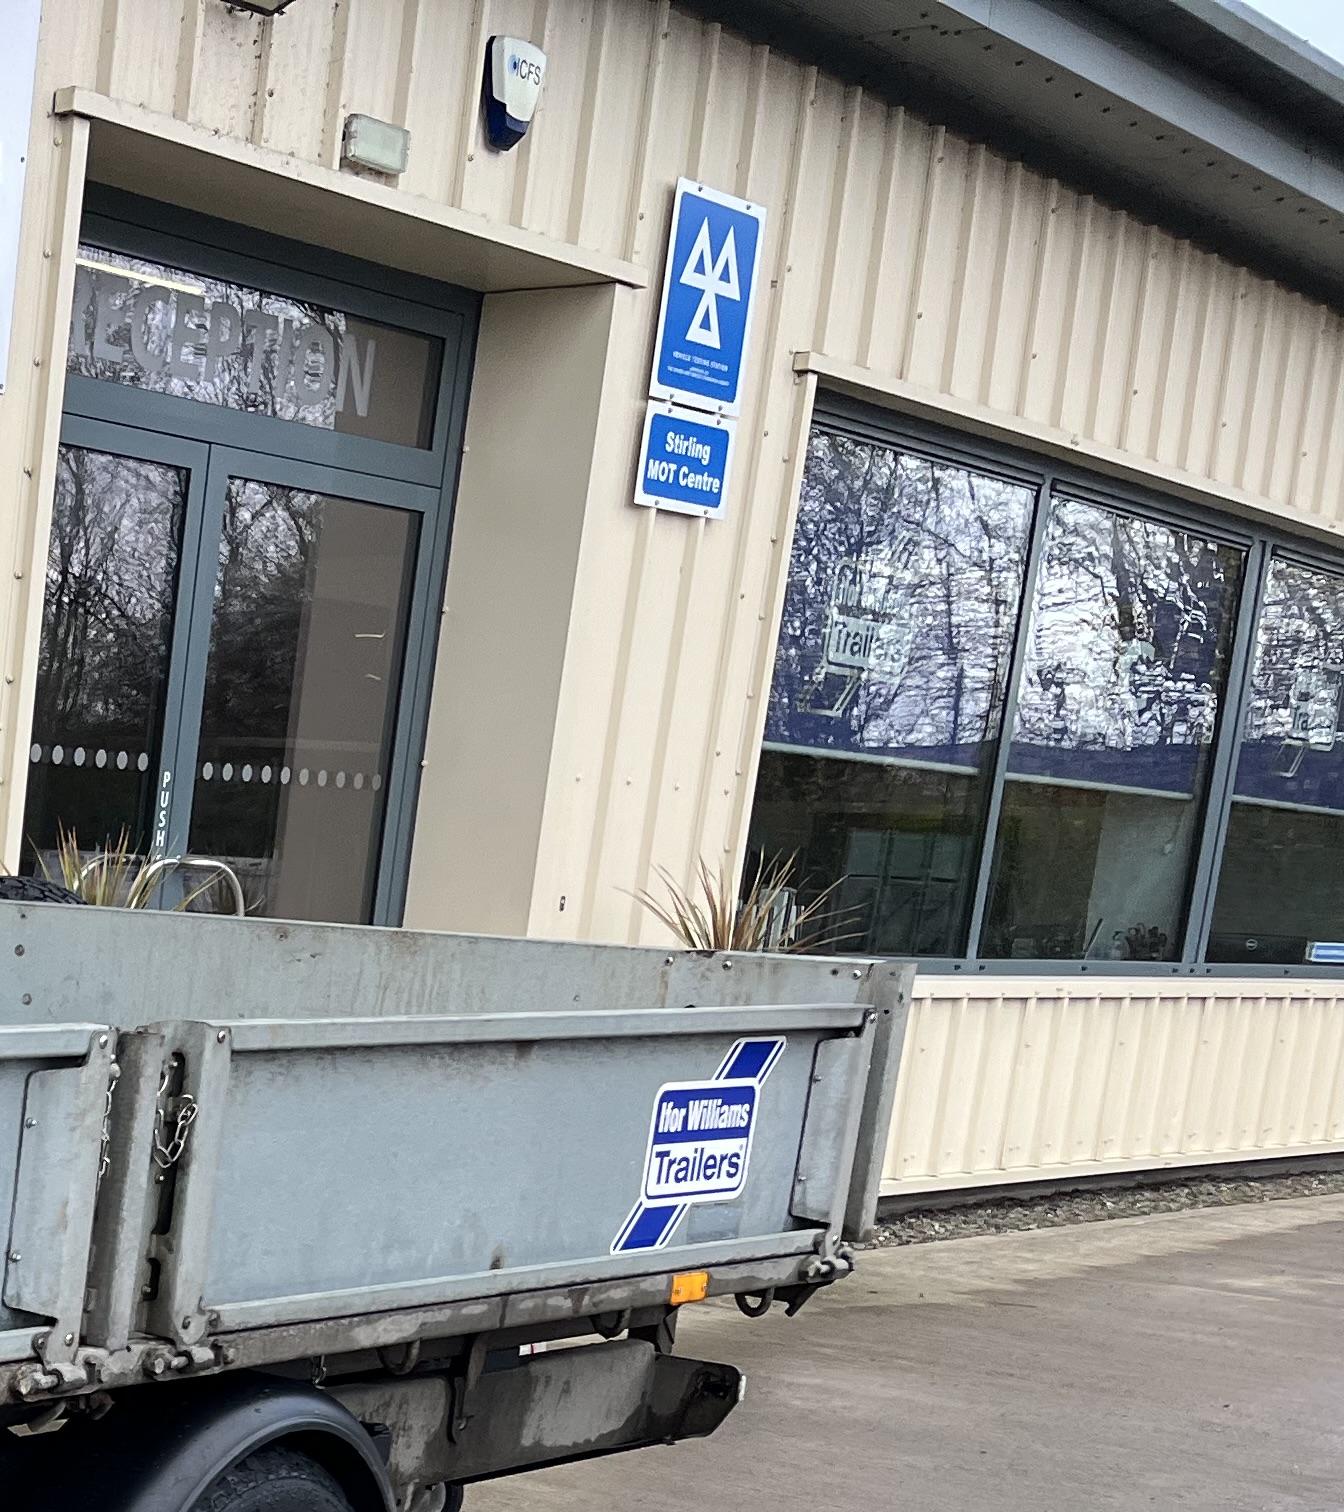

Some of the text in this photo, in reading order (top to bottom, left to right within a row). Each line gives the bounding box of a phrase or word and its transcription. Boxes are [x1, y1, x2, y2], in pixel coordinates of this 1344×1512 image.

[665, 431, 711, 466] Stirling
[646, 459, 721, 494] MOT Centre
[155, 771, 171, 847] PUSH
[657, 1098, 751, 1133] Ifor Williams
[654, 1147, 741, 1185] Trailers
